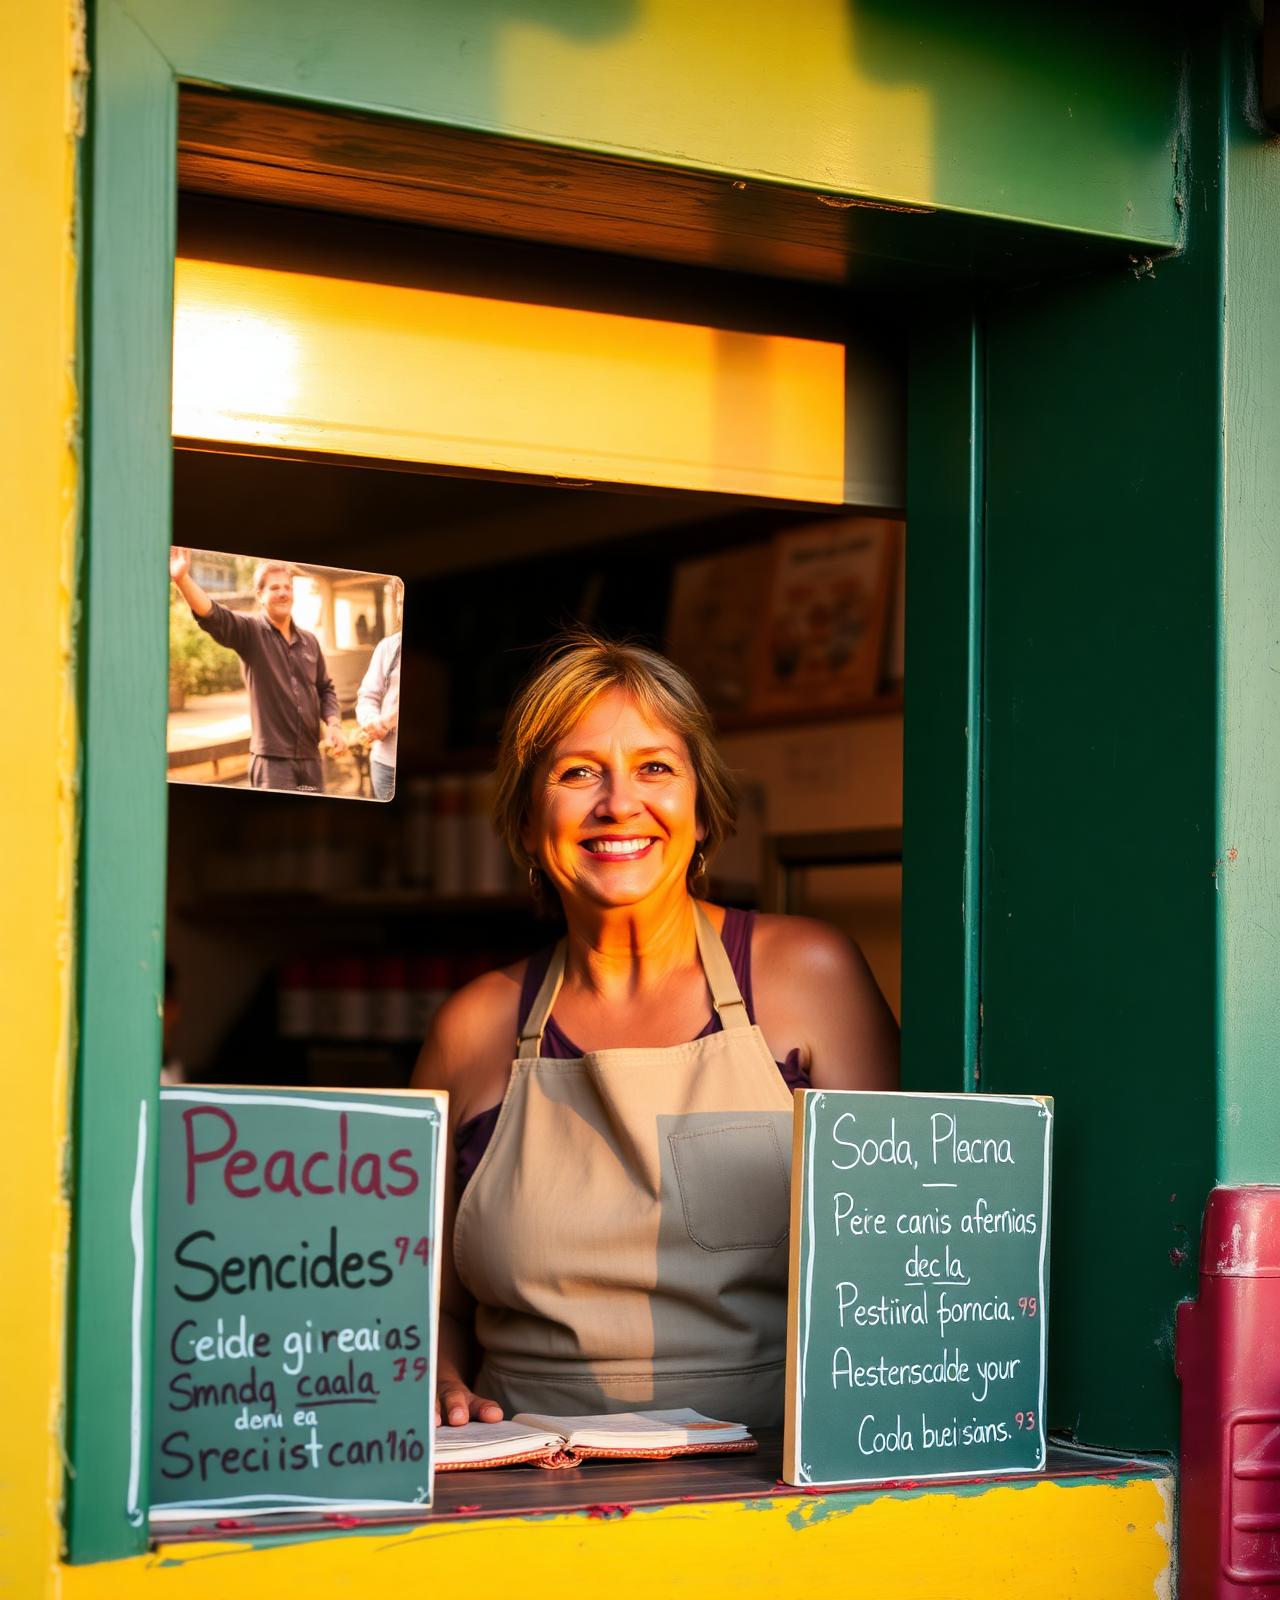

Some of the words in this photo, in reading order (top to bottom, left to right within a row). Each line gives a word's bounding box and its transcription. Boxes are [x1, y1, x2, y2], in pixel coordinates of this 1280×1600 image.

[832, 1112, 918, 1170] Soda,
[834, 1192, 887, 1236] Peire
[896, 1208, 952, 1235] canis
[174, 1226, 394, 1302] Sencides
[972, 1359, 1021, 1402] your
[1015, 1411, 1036, 1431] 93
